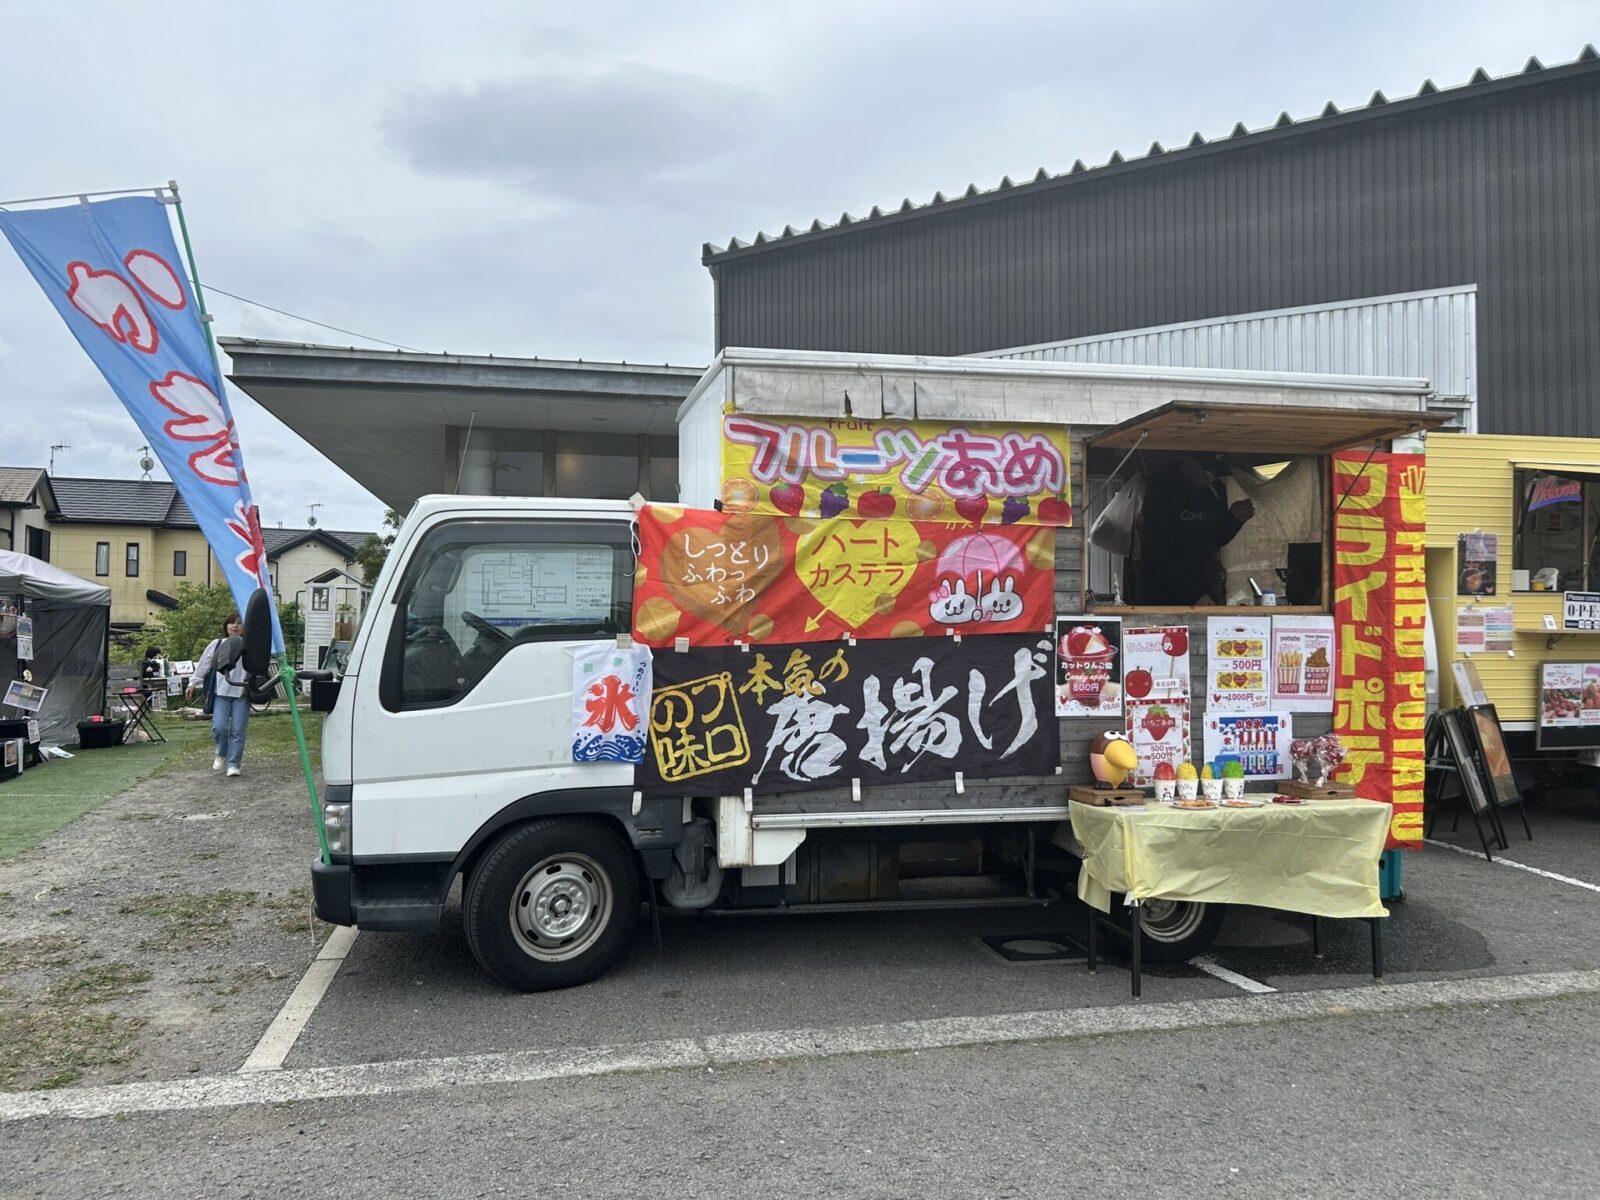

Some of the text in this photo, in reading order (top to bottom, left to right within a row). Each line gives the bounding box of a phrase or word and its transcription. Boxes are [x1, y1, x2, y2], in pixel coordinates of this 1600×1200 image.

[825, 417, 875, 431] fruit
[725, 416, 1066, 496] フルーツあめ
[811, 528, 900, 559] ハート
[809, 563, 905, 590] カステラ
[710, 585, 756, 605] ふわ
[1334, 459, 1387, 785] フライドポテ
[1127, 641, 1173, 653] りんごあめ
[739, 648, 849, 705] 本気の
[1064, 672, 1111, 682] Candy apple
[1232, 660, 1261, 671] 500円
[1072, 683, 1099, 692] 800円
[1228, 693, 1254, 701] 1000円
[582, 674, 641, 733] 氷
[751, 640, 1054, 785] 唐揚げ
